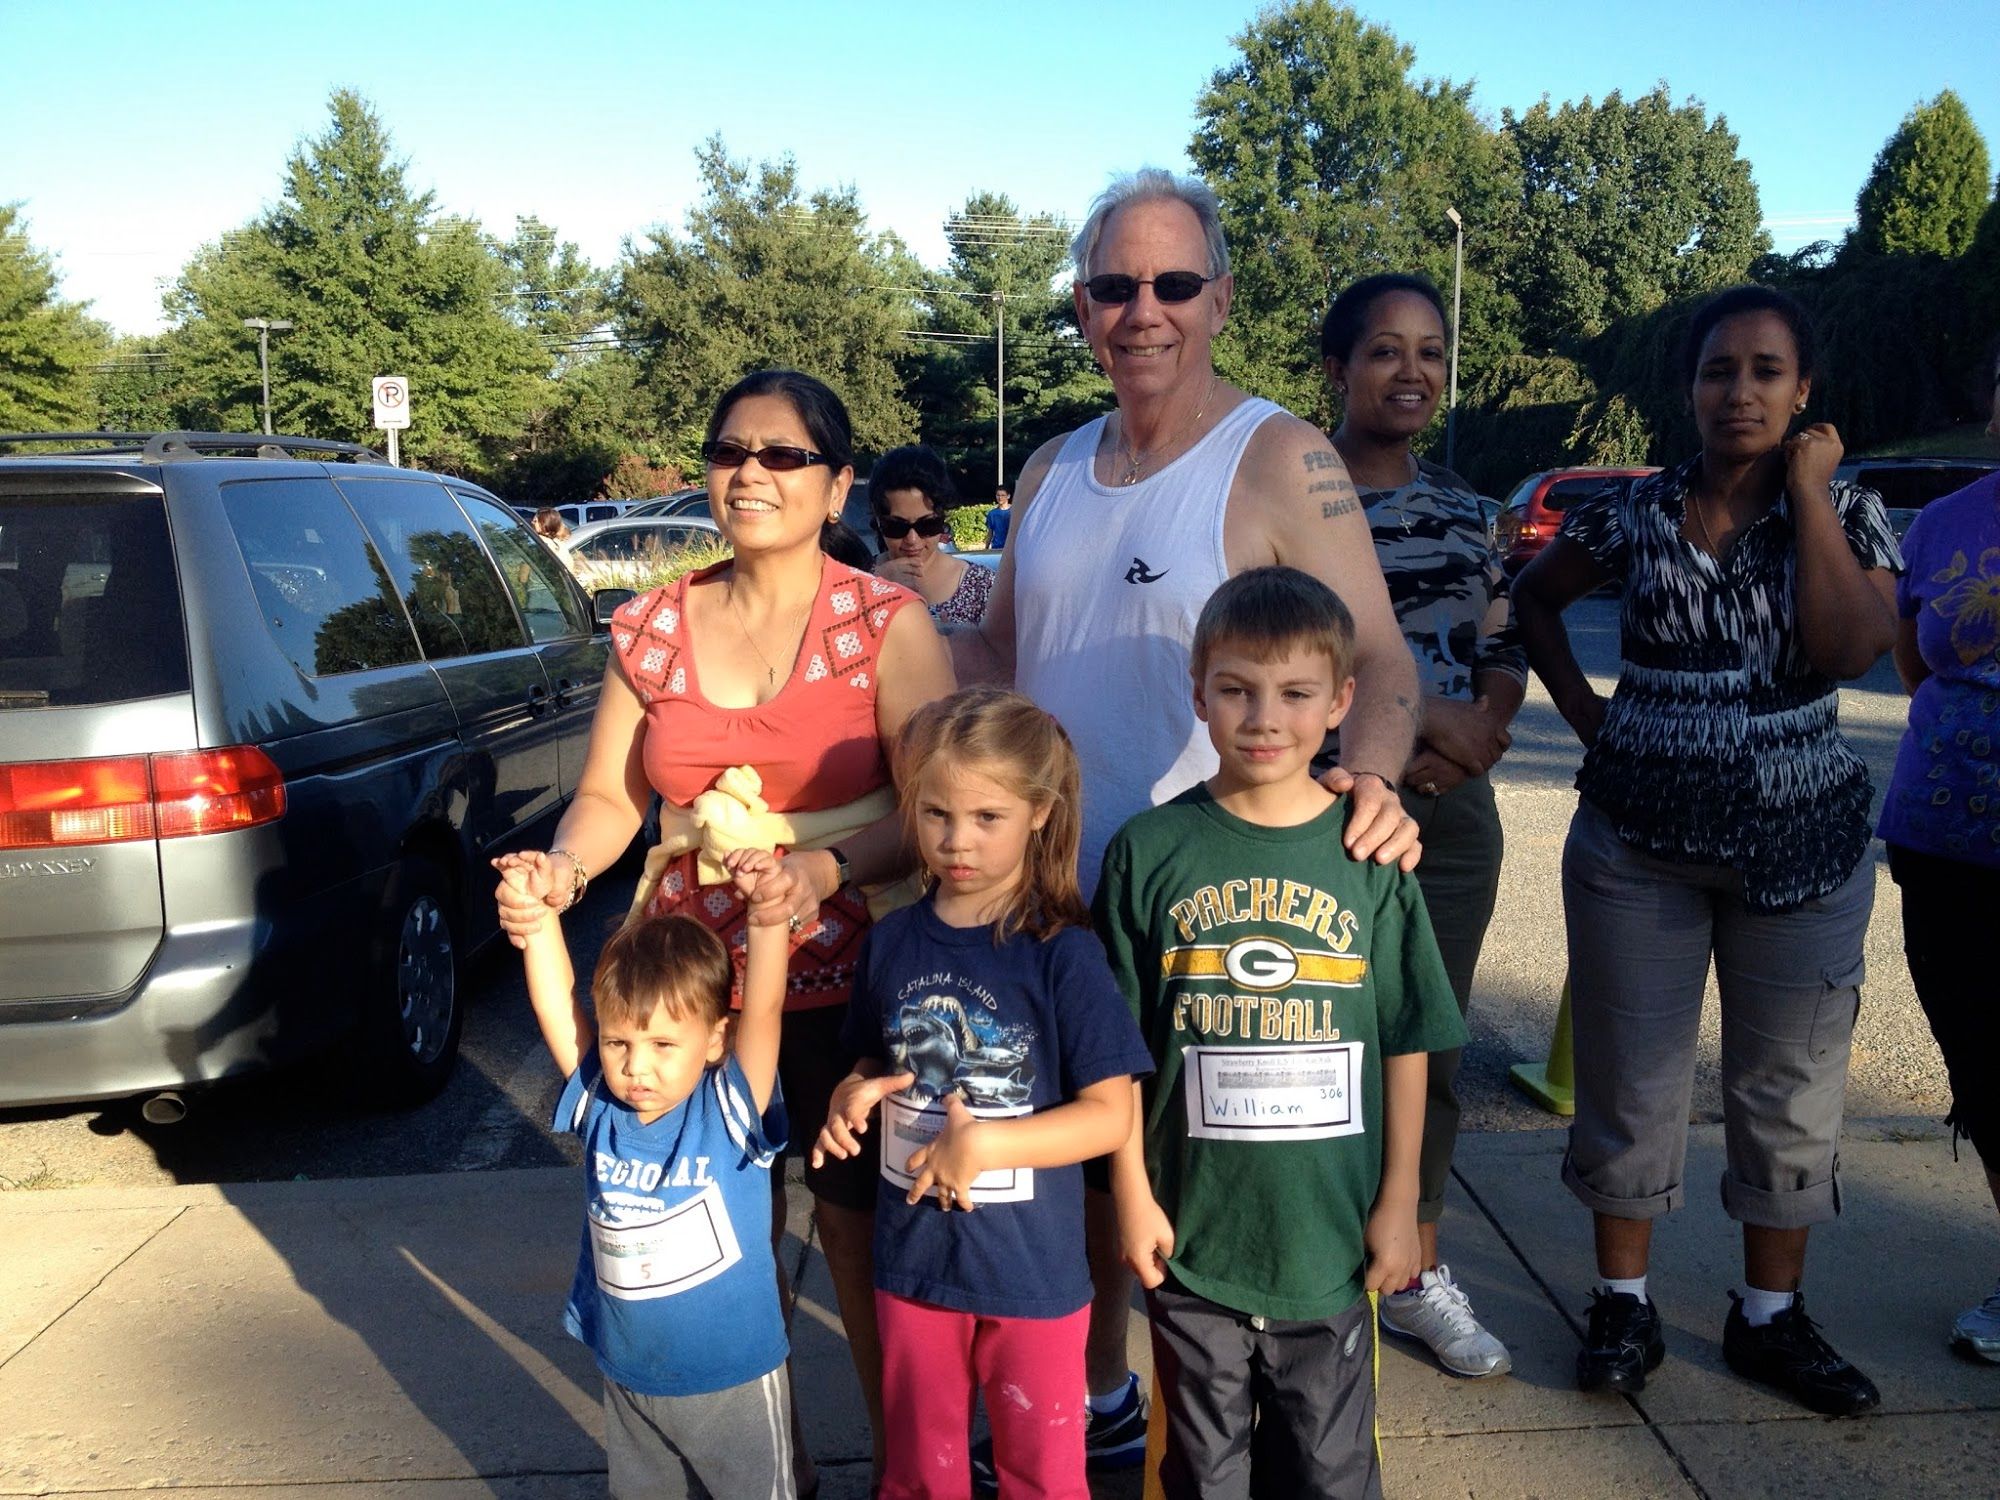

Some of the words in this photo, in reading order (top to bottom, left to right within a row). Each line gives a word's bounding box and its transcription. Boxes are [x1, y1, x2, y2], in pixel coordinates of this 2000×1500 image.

[1169, 877, 1360, 953] PACKERS
[1226, 938, 1297, 988] G
[898, 972, 952, 1001] CATALINA
[957, 976, 998, 1012] ISLAND
[1173, 992, 1340, 1042] FOOTBALL
[1209, 1095, 1304, 1118] William
[1320, 1087, 1343, 1100] 306
[596, 1152, 713, 1191] EGIOAL
